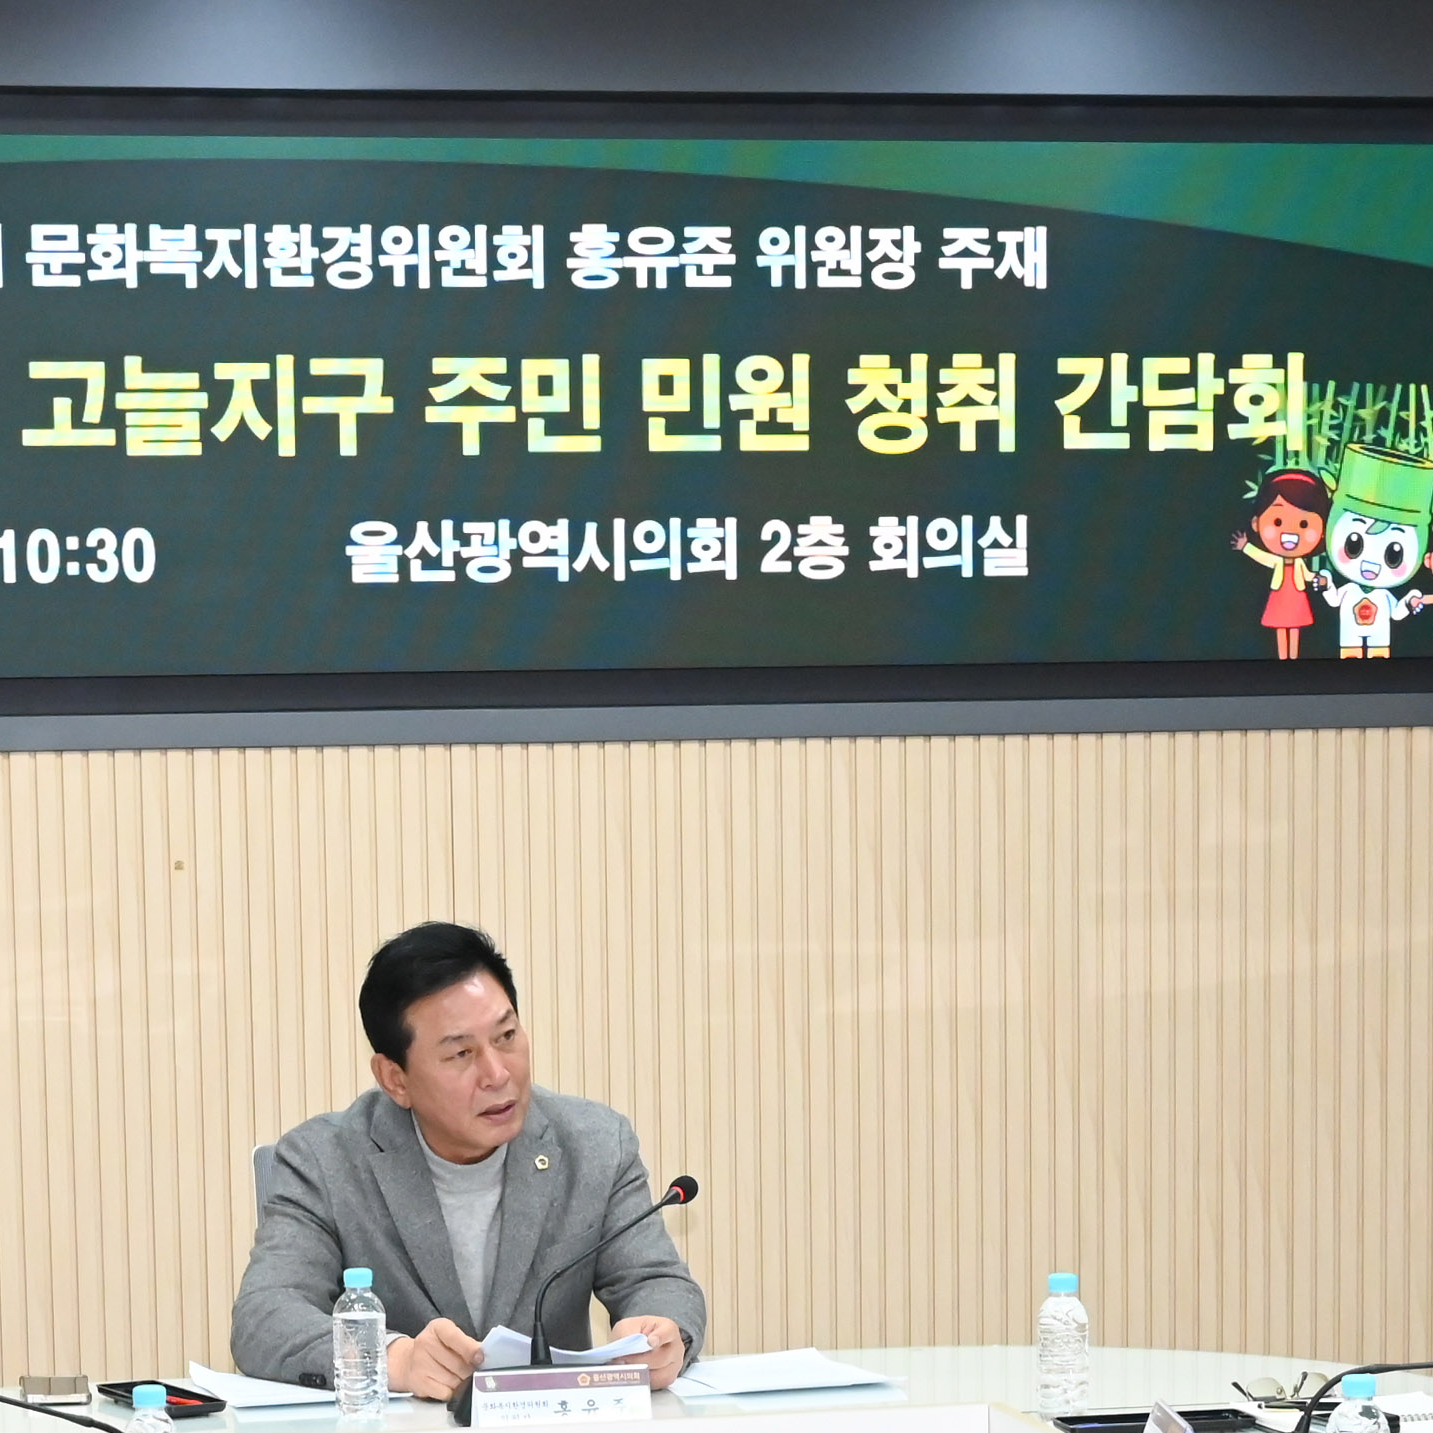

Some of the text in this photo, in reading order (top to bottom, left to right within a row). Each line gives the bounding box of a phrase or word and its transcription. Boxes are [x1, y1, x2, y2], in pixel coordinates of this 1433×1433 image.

[25, 222, 545, 290] 문화복지환경위원회
[566, 223, 737, 290] 홍유준
[755, 224, 922, 290] 위원장
[938, 224, 1049, 290] 주재
[21, 353, 395, 458] 고늘지구
[424, 353, 602, 456] 주민
[641, 352, 811, 452] 민원
[844, 352, 1017, 455] 청취
[1054, 351, 1307, 453] 간담회
[344, 514, 1029, 586] 울산광역시의회 2층 회의실
